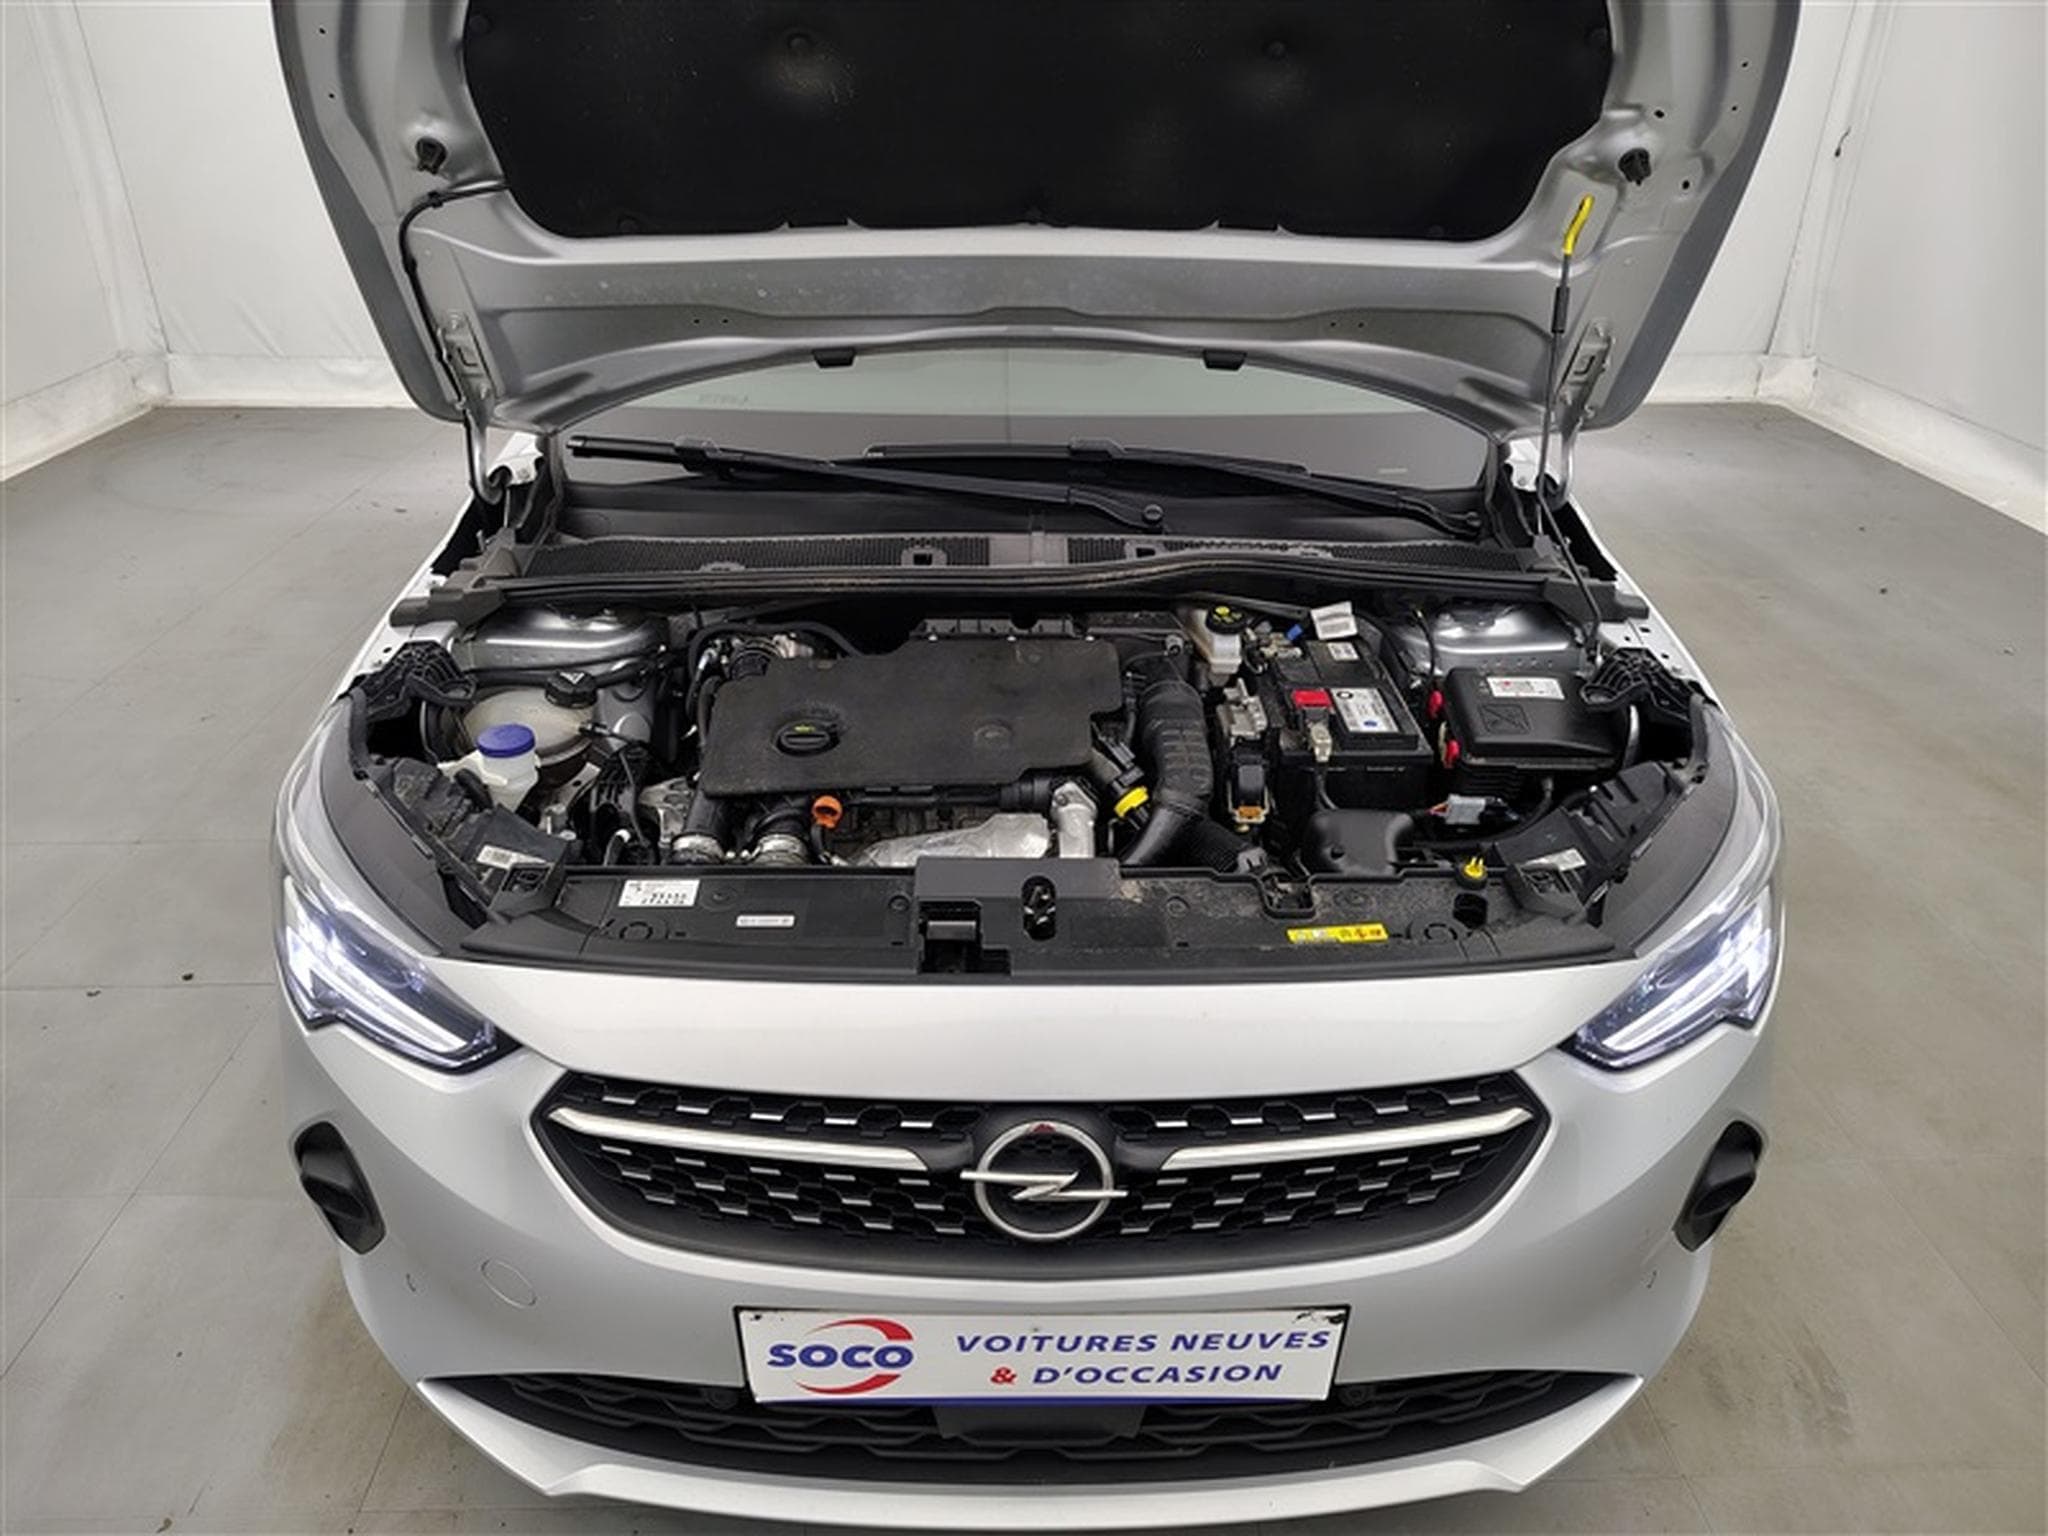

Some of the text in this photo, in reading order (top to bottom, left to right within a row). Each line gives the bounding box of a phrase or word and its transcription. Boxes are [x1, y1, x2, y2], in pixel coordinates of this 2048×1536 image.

[956, 1331, 1331, 1353] VOITURES NEUVES
[767, 1344, 914, 1369] SOCO
[990, 1364, 1283, 1384] & D'OCCASION
